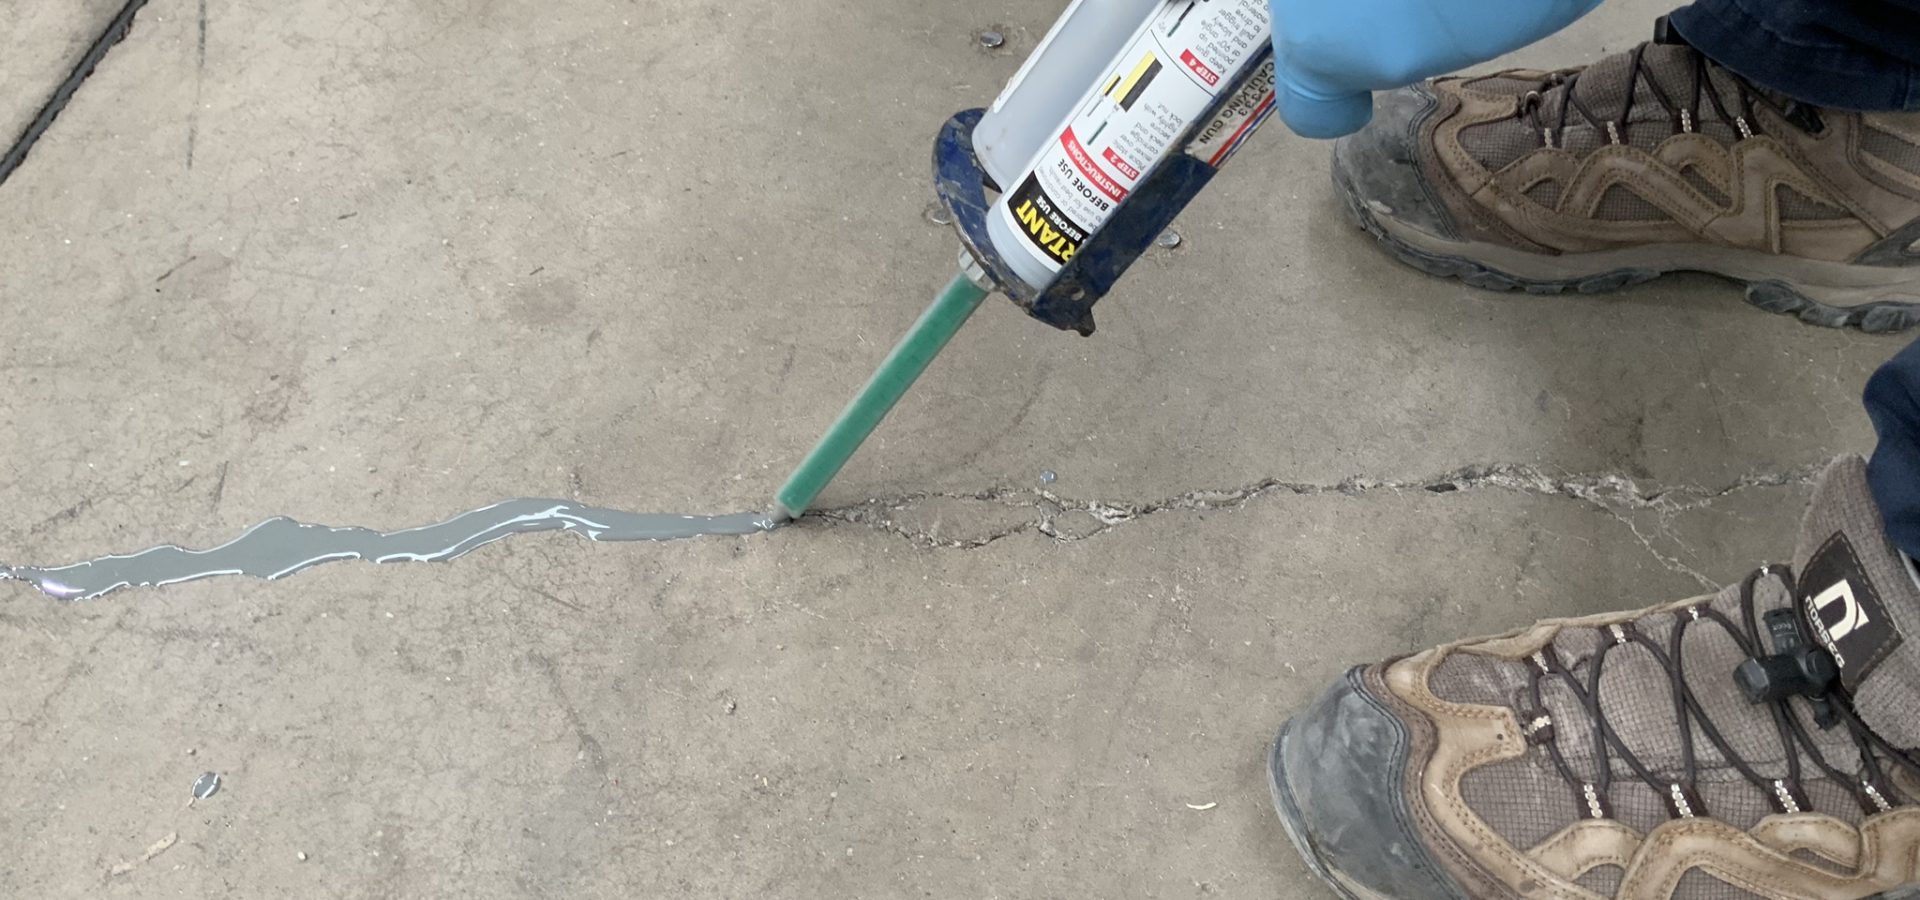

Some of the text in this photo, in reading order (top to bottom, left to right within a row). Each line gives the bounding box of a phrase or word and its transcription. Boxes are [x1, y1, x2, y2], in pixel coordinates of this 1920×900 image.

[1201, 20, 1219, 38] angle
[1211, 16, 1247, 48] and slowly
[1219, 9, 1256, 40] pull trigger
[1236, 9, 1262, 33] to drive
[1195, 44, 1226, 75] Keep gun
[1199, 33, 1234, 65] pointed up
[1188, 57, 1217, 84] STEP 4
[1199, 62, 1275, 144] CAULKING GUN
[1144, 103, 1177, 133] tightly with
[1150, 122, 1171, 140] secure
[1169, 113, 1184, 127] lock
[1120, 134, 1152, 162] mixer over
[1130, 130, 1158, 155] cartridge
[1135, 122, 1164, 147] neck and
[1068, 140, 1122, 197] INSTRUCTIONS
[1110, 155, 1137, 179] STEP 2
[1129, 154, 1146, 171] Place
[1058, 158, 1109, 212] BEFORE USE
[1036, 195, 1083, 242] BEFORE USE
[1067, 206, 1088, 223] stored
